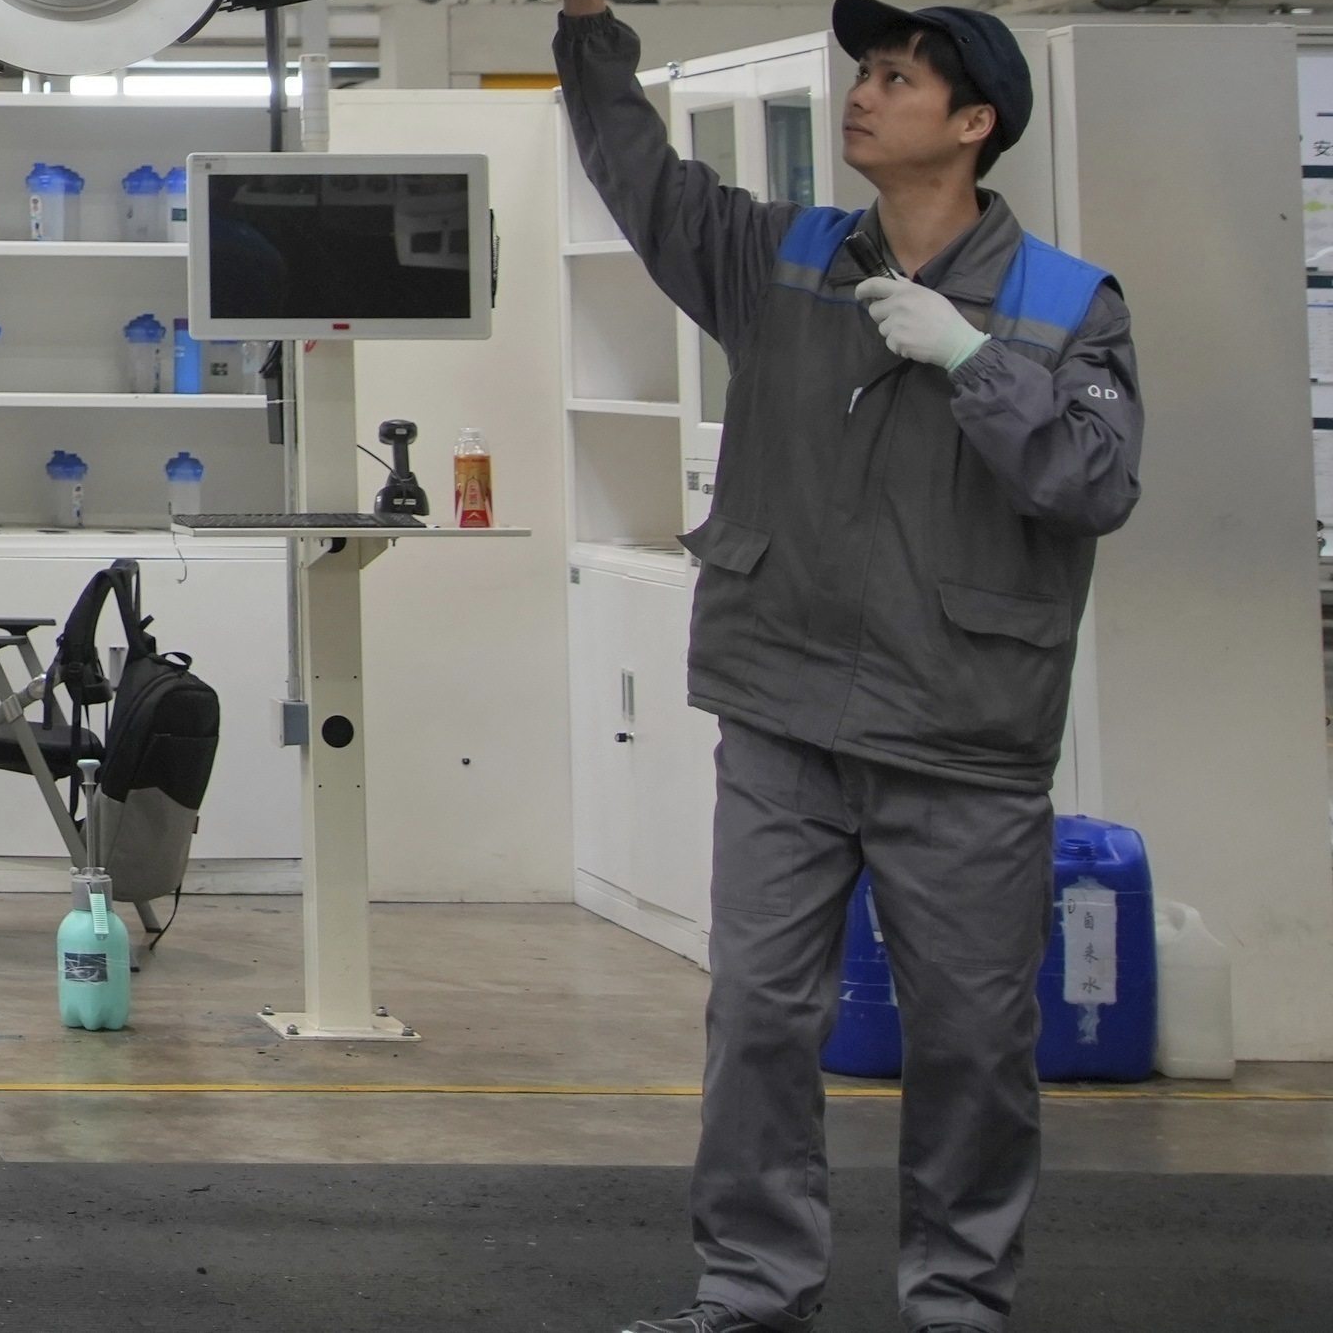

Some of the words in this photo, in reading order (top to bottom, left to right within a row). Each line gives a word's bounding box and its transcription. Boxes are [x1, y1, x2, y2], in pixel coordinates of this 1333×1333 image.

[1313, 140, 1333, 158] 安
[1081, 911, 1102, 995] 自来水
